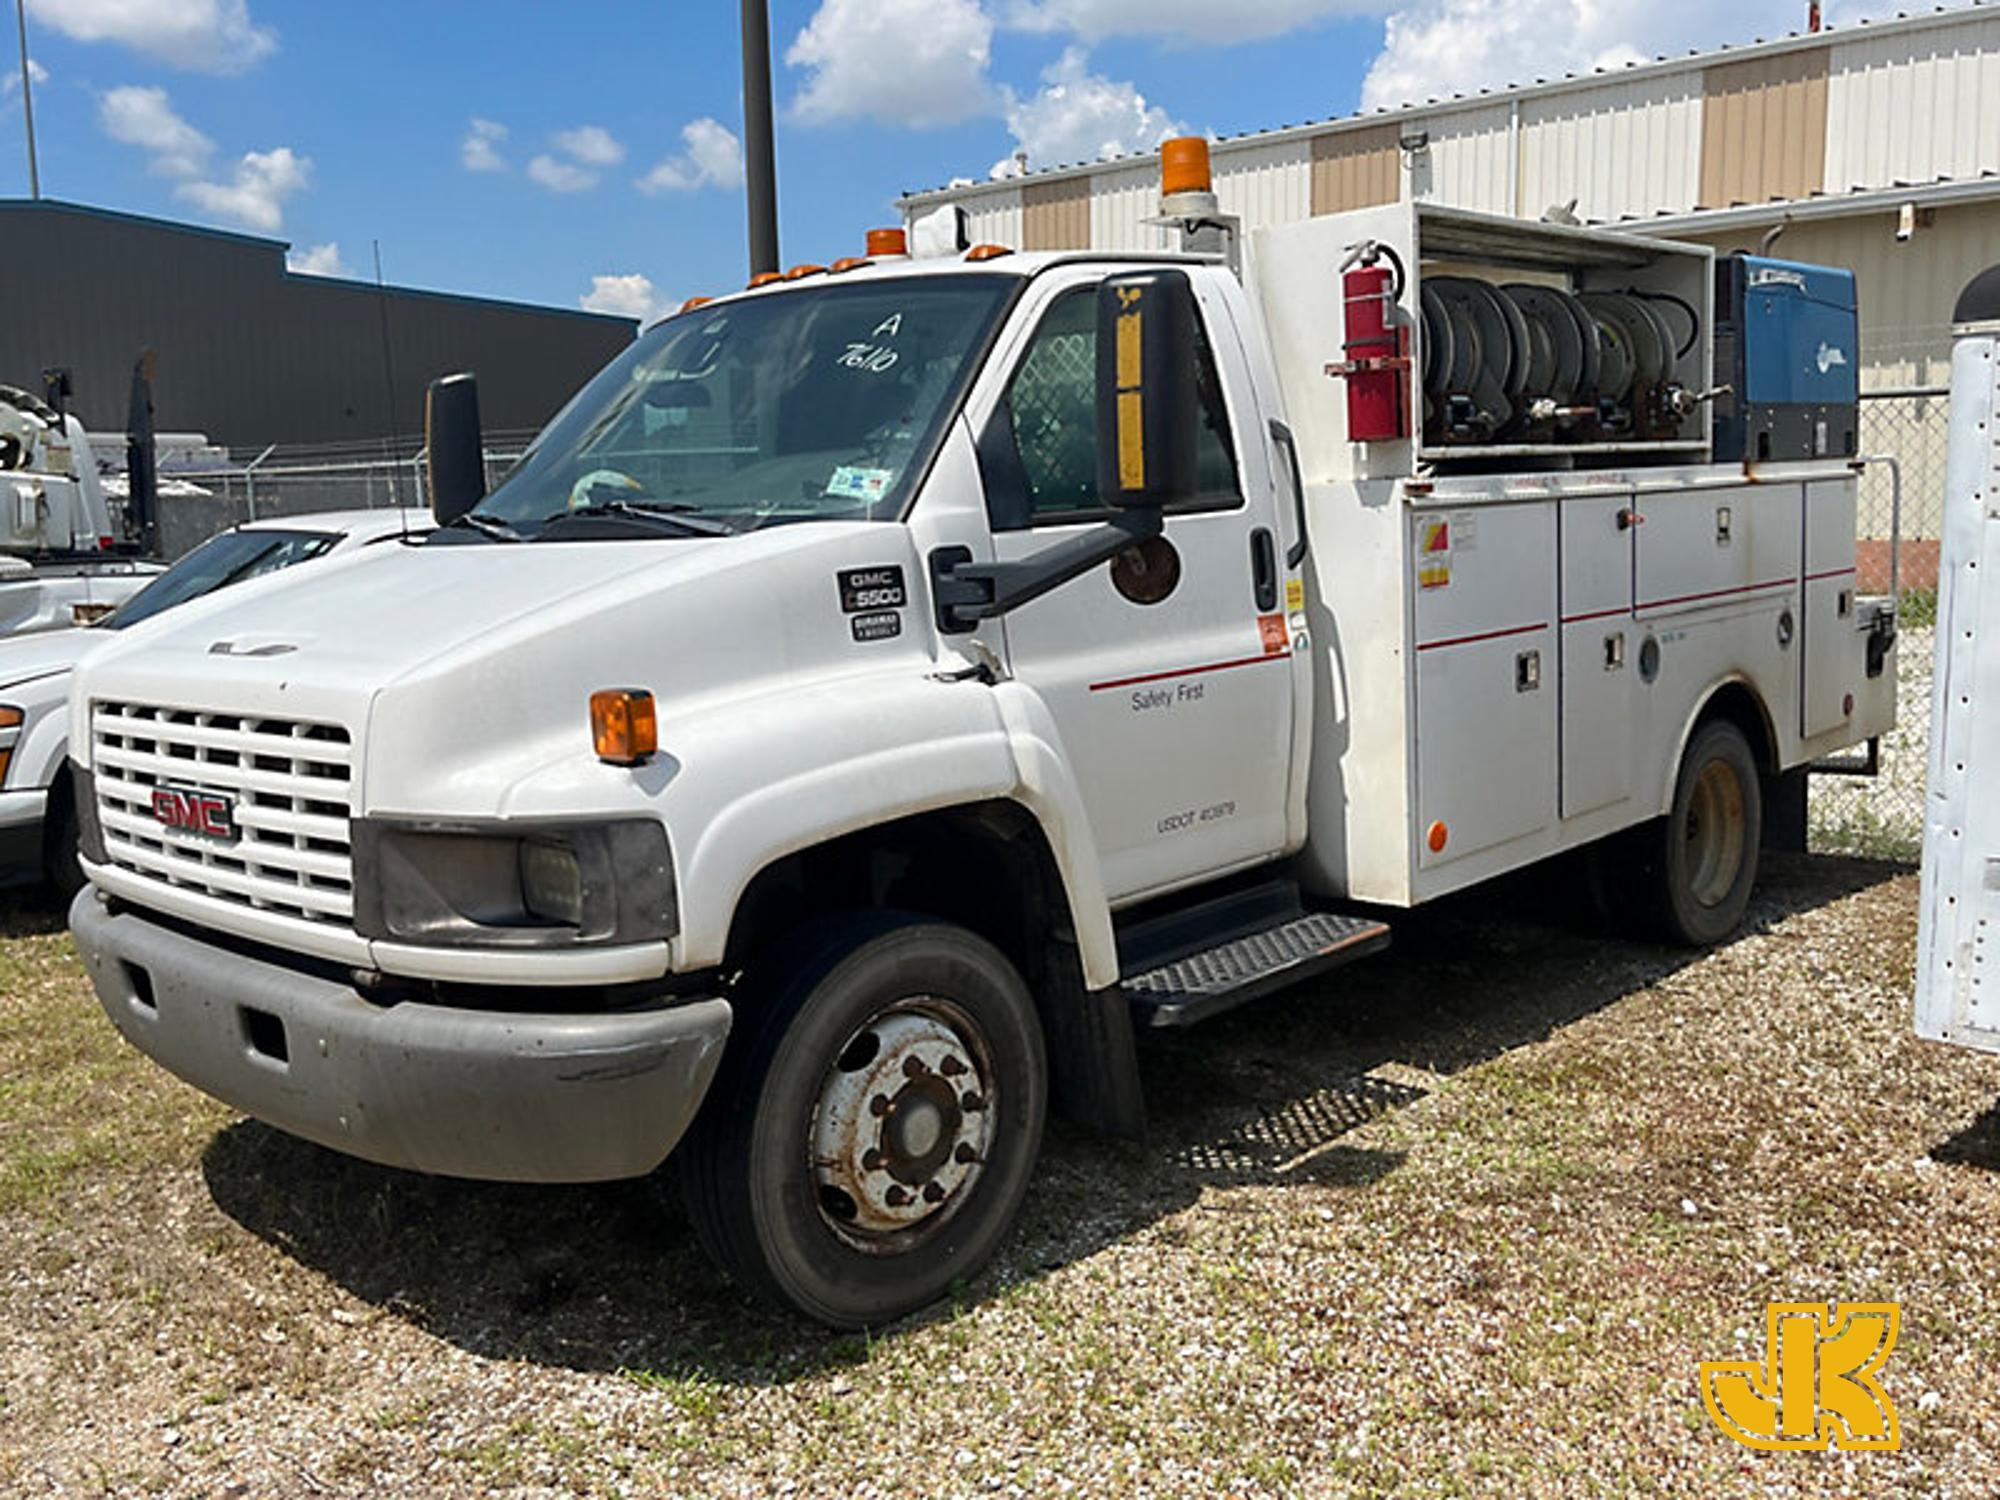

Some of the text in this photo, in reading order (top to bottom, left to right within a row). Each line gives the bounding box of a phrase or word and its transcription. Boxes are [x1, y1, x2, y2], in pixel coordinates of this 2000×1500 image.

[872, 312, 902, 337] A
[850, 572, 893, 587] GMC
[1131, 683, 1204, 711] Safety First
[151, 790, 231, 837] GMC
